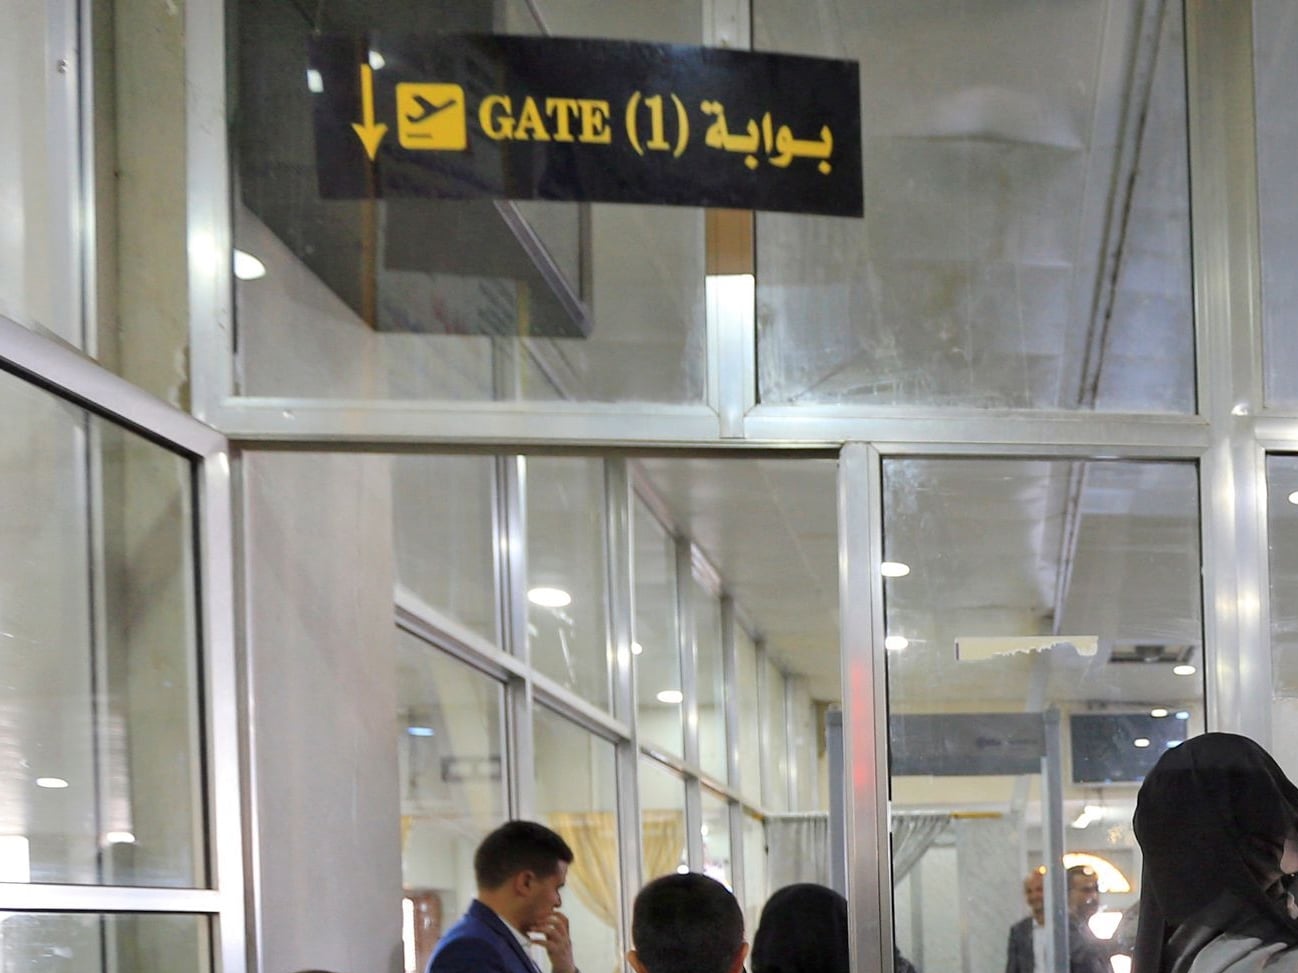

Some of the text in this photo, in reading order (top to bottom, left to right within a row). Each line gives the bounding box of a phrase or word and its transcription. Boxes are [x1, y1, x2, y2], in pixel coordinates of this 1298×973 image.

[478, 91, 690, 157] GATE (1)
[700, 101, 833, 175] بوابة
